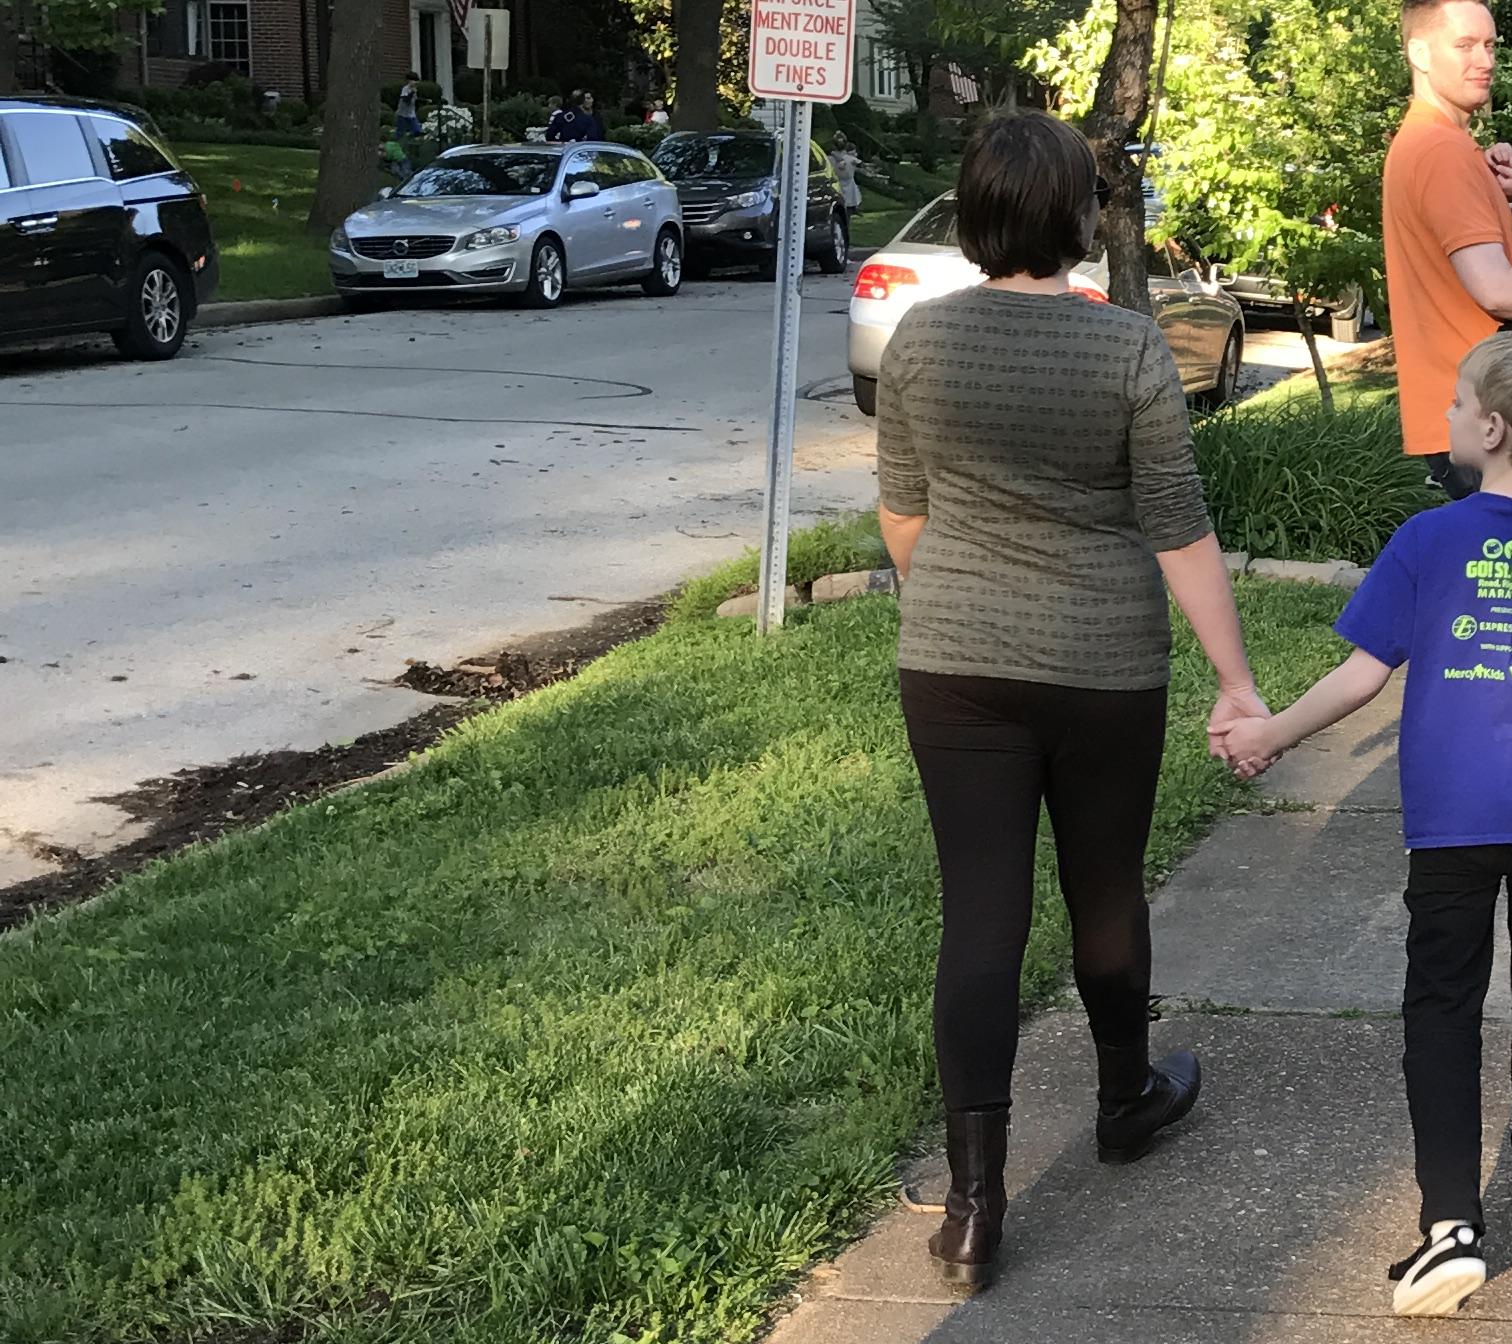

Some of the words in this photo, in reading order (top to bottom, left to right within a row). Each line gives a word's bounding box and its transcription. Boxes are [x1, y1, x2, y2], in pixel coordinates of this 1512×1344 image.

[757, 10, 801, 31] MENT
[803, 13, 846, 35] ZONE
[765, 36, 836, 61] DOUBLE
[775, 63, 826, 86] FINES
[1444, 668, 1475, 681] Mercy
